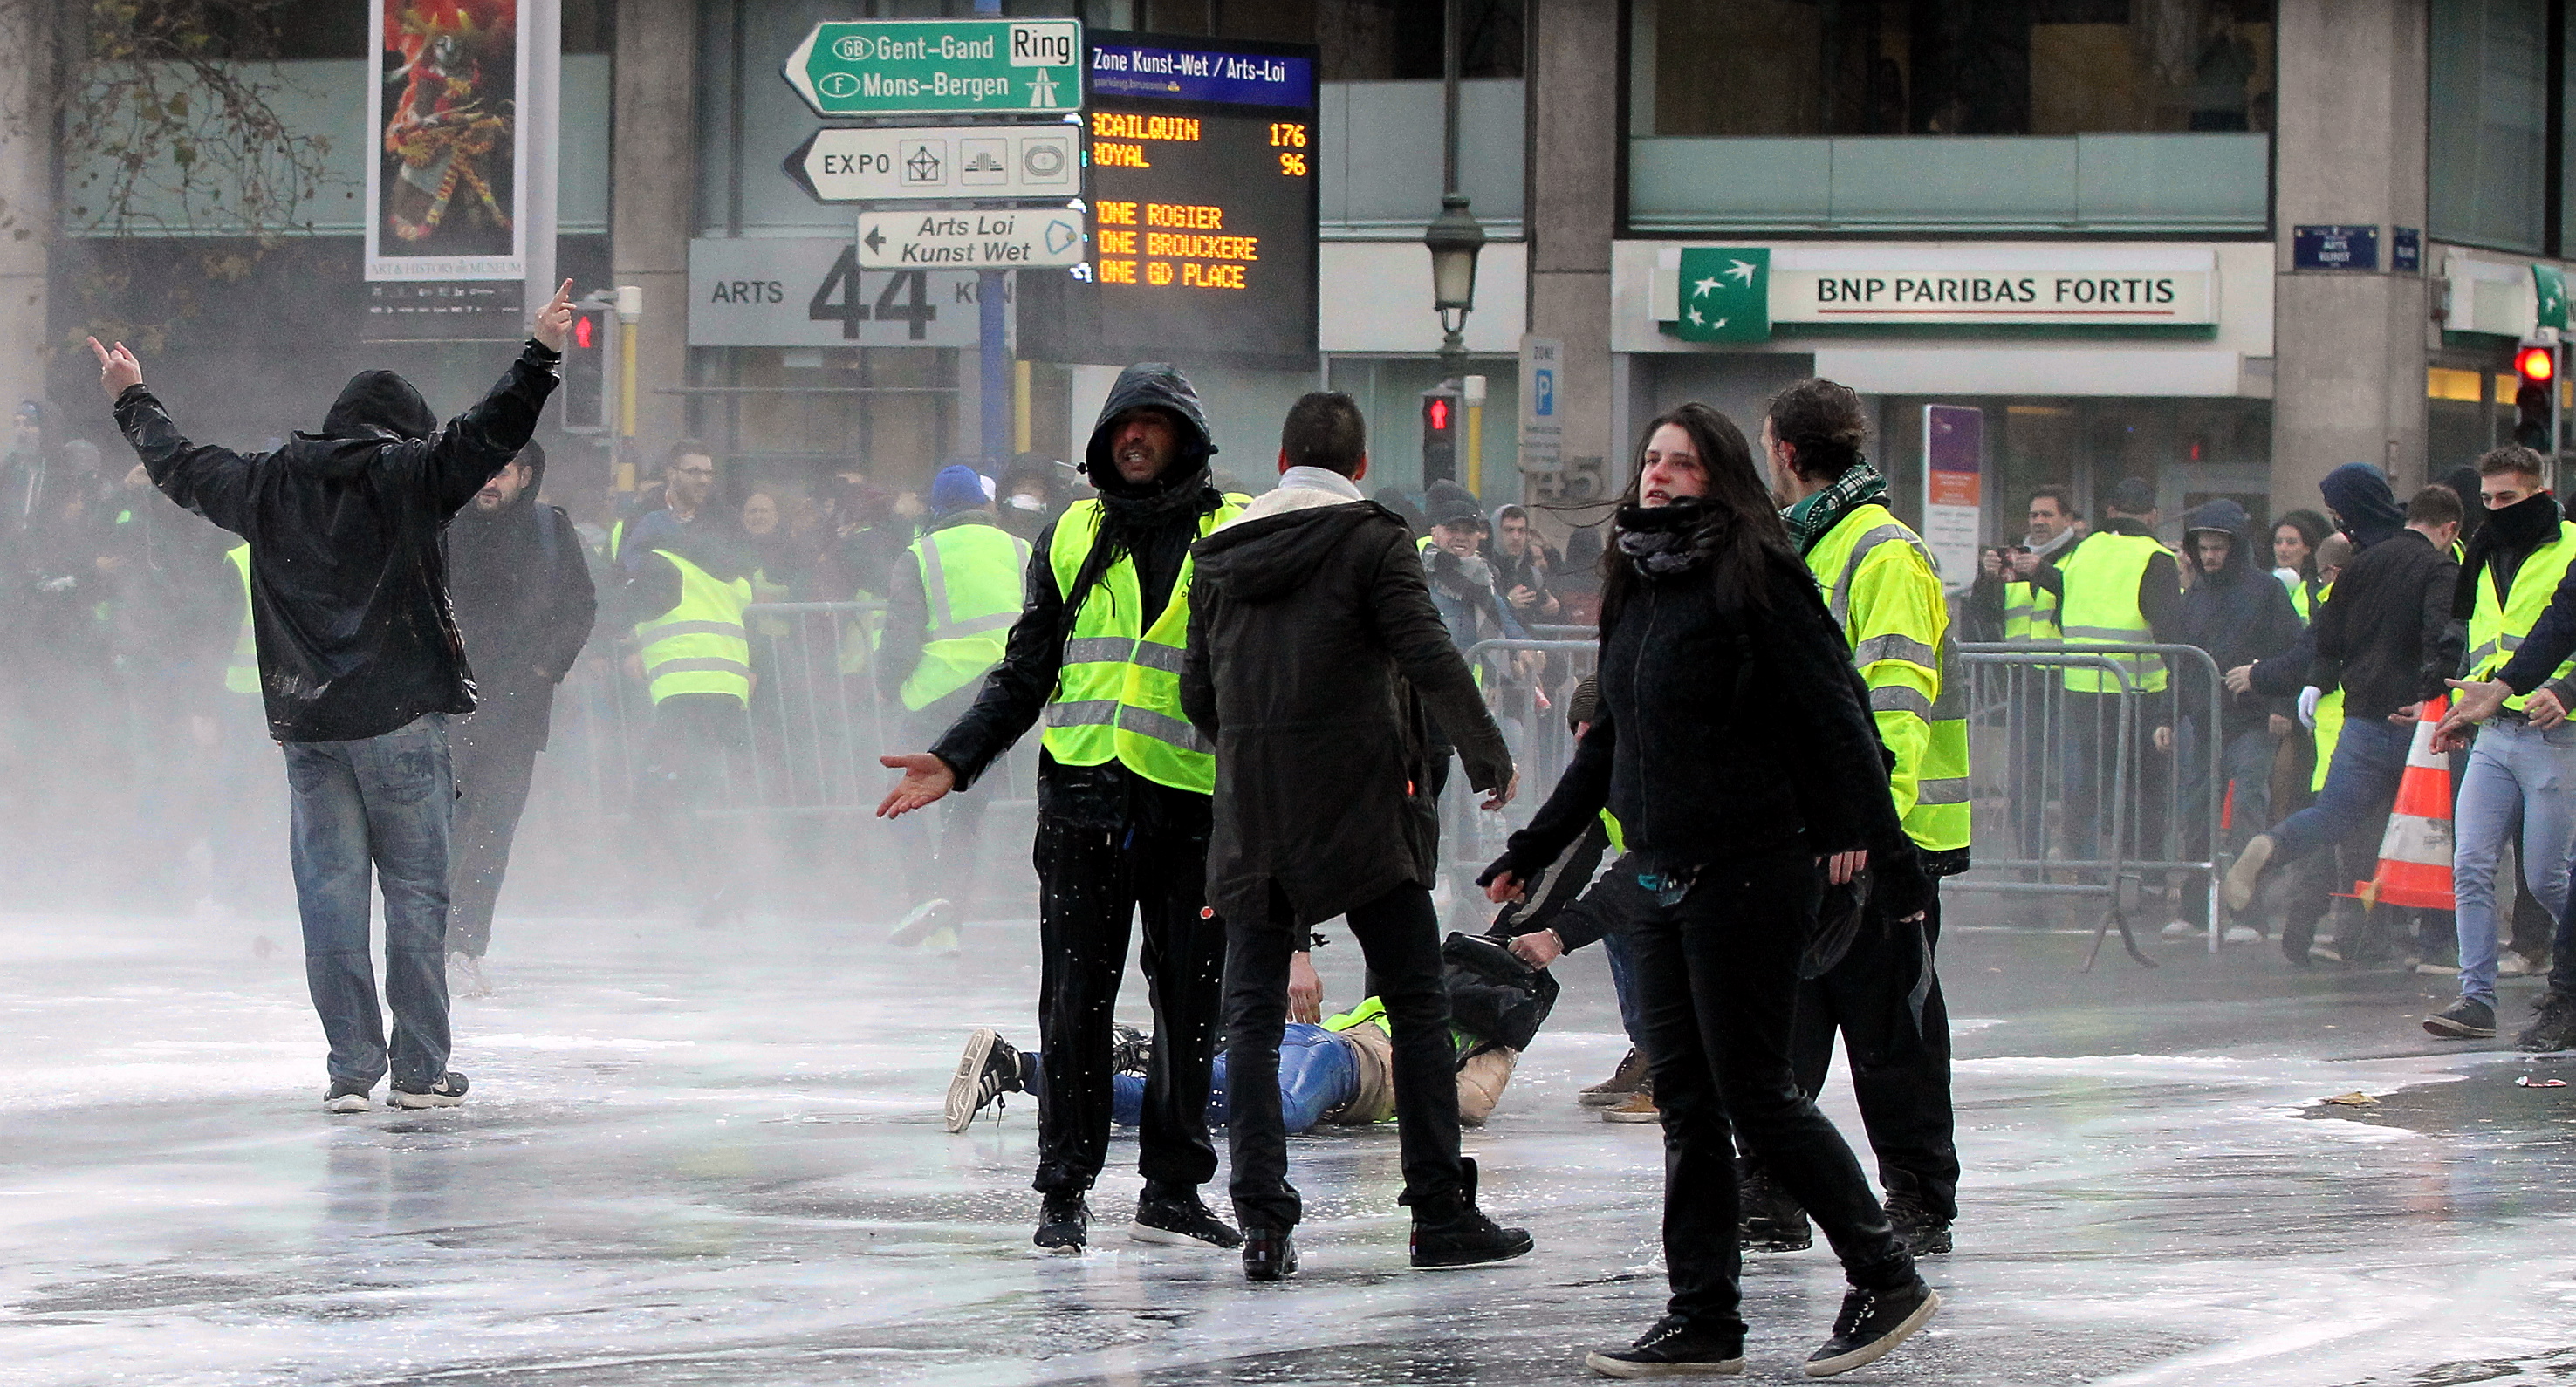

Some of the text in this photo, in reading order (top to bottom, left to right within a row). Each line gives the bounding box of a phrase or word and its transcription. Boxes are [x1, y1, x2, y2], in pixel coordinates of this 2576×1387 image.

[843, 34, 994, 60] GB Gent-Gand
[1014, 29, 1070, 65] Ring
[1093, 48, 1127, 71] Zone
[1133, 51, 1209, 77] Kunst-Wet
[1227, 57, 1285, 83] Arts-Loi
[835, 72, 1009, 102] F Mons-Bergen
[1269, 122, 1307, 147] 176
[824, 154, 890, 174] EXPO
[1279, 152, 1307, 176] 96
[917, 215, 1016, 236] Arts Loi
[1146, 202, 1223, 229] ROGIER
[901, 242, 1031, 263] Kunst Wet
[1098, 229, 1259, 261] ONE BROUCKERE
[470, 262, 524, 274] MUSEUM
[1098, 259, 1247, 289] ONE GD PLACE
[711, 243, 936, 340] ARTS 44
[1818, 278, 2175, 303] BNP PARIBAS FORTIS
